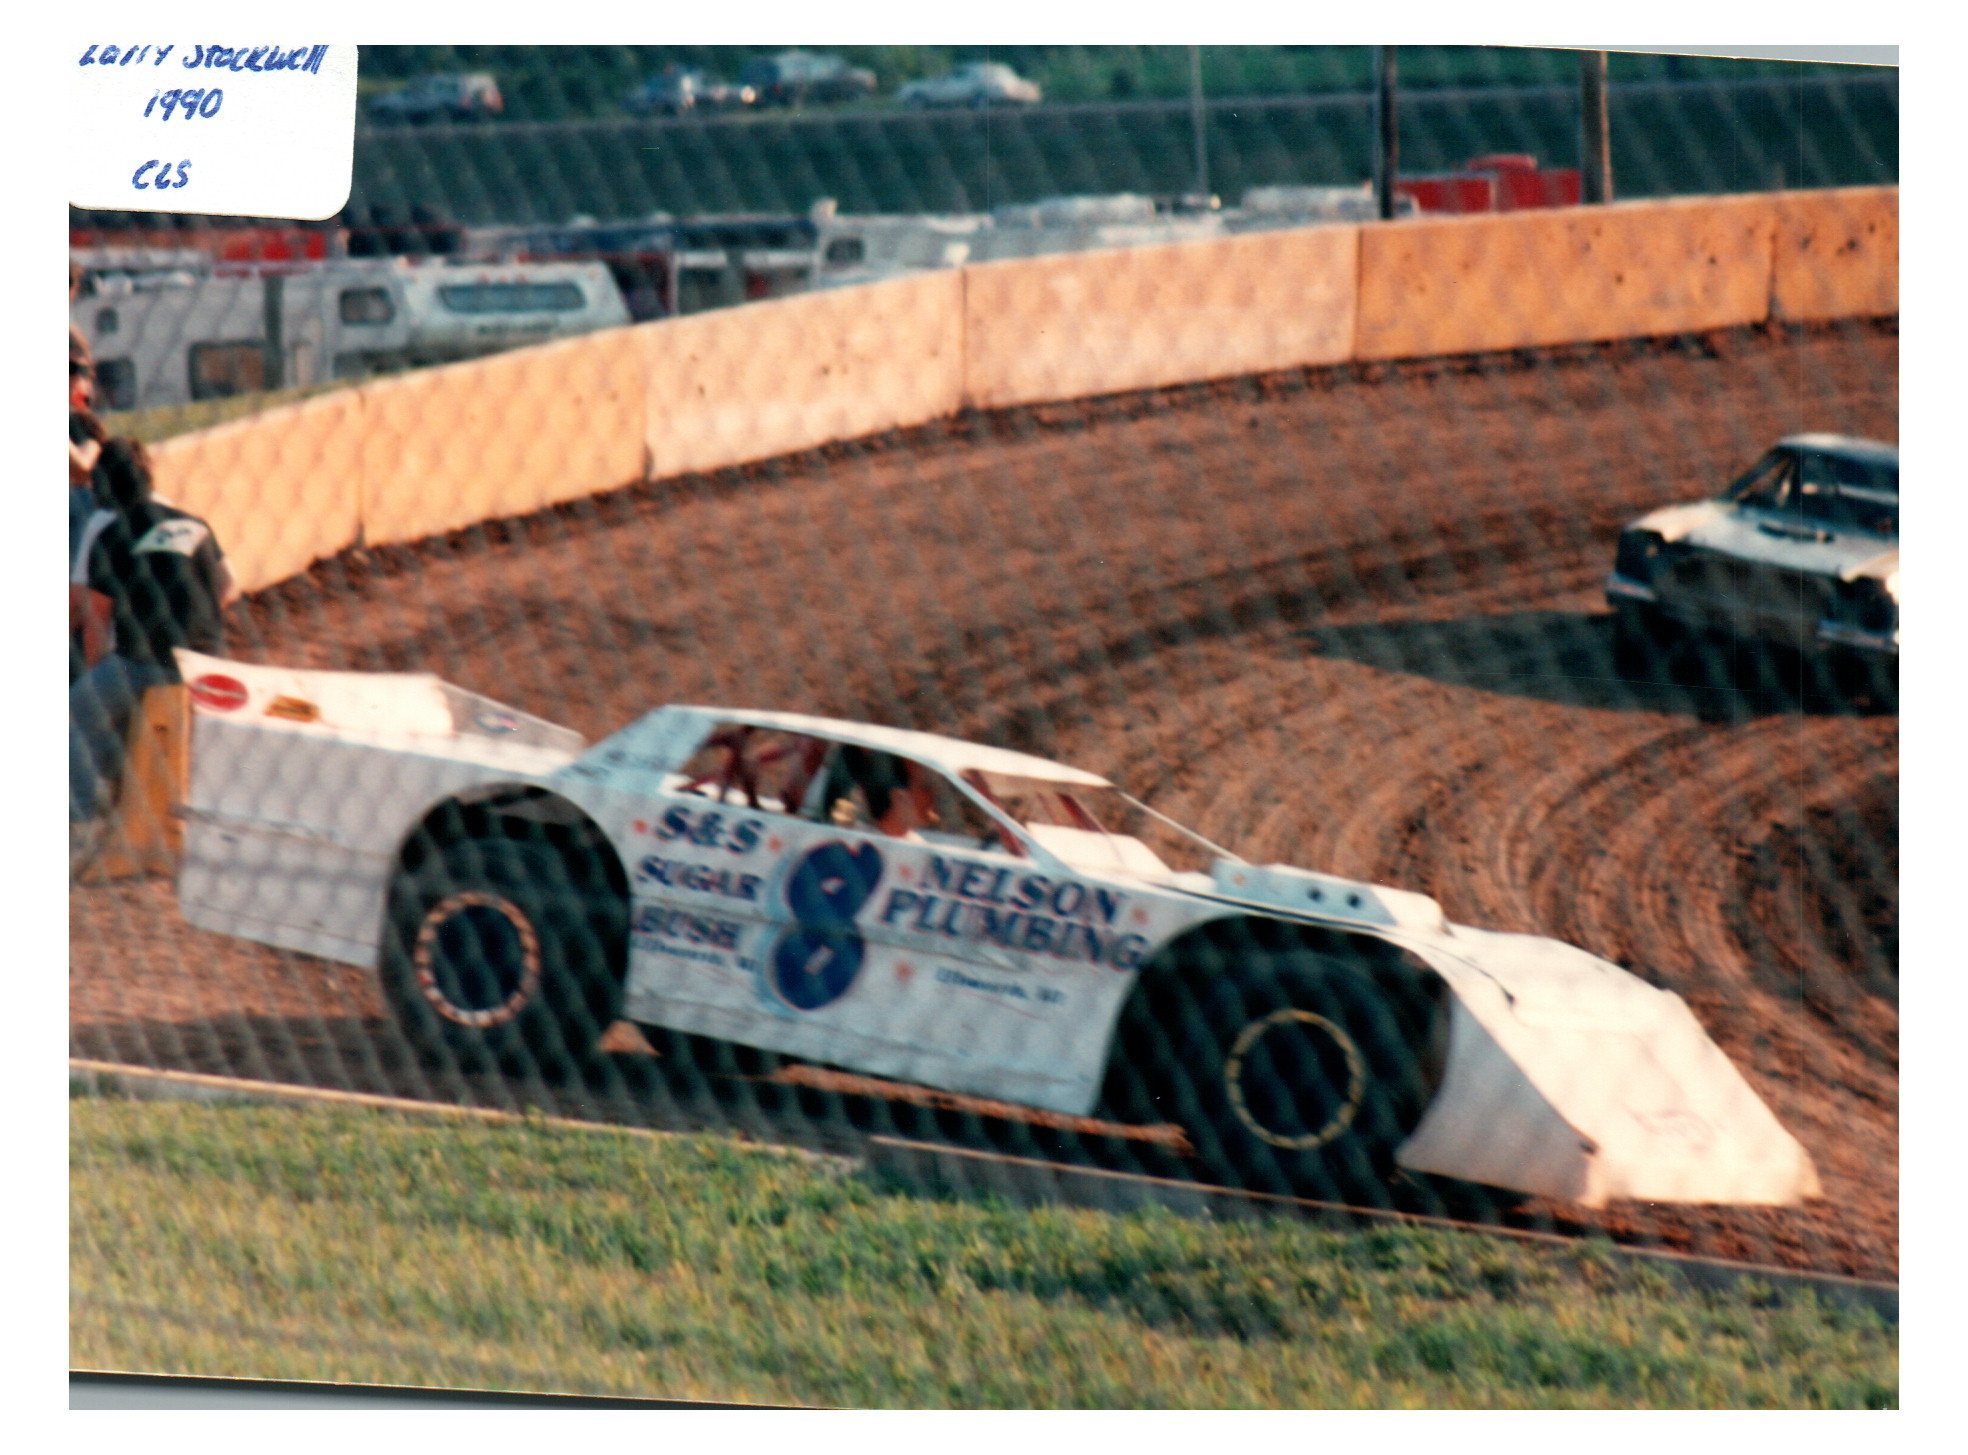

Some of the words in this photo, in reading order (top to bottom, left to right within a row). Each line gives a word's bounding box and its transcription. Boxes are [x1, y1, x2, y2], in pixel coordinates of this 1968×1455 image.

[78, 45, 174, 66] Larry
[143, 88, 223, 121] 1990
[656, 805, 764, 856] S&S
[635, 854, 763, 902] SUGAR
[919, 854, 1132, 925] NELSON
[767, 839, 885, 1012] 8
[880, 886, 1150, 973] PLUMBING
